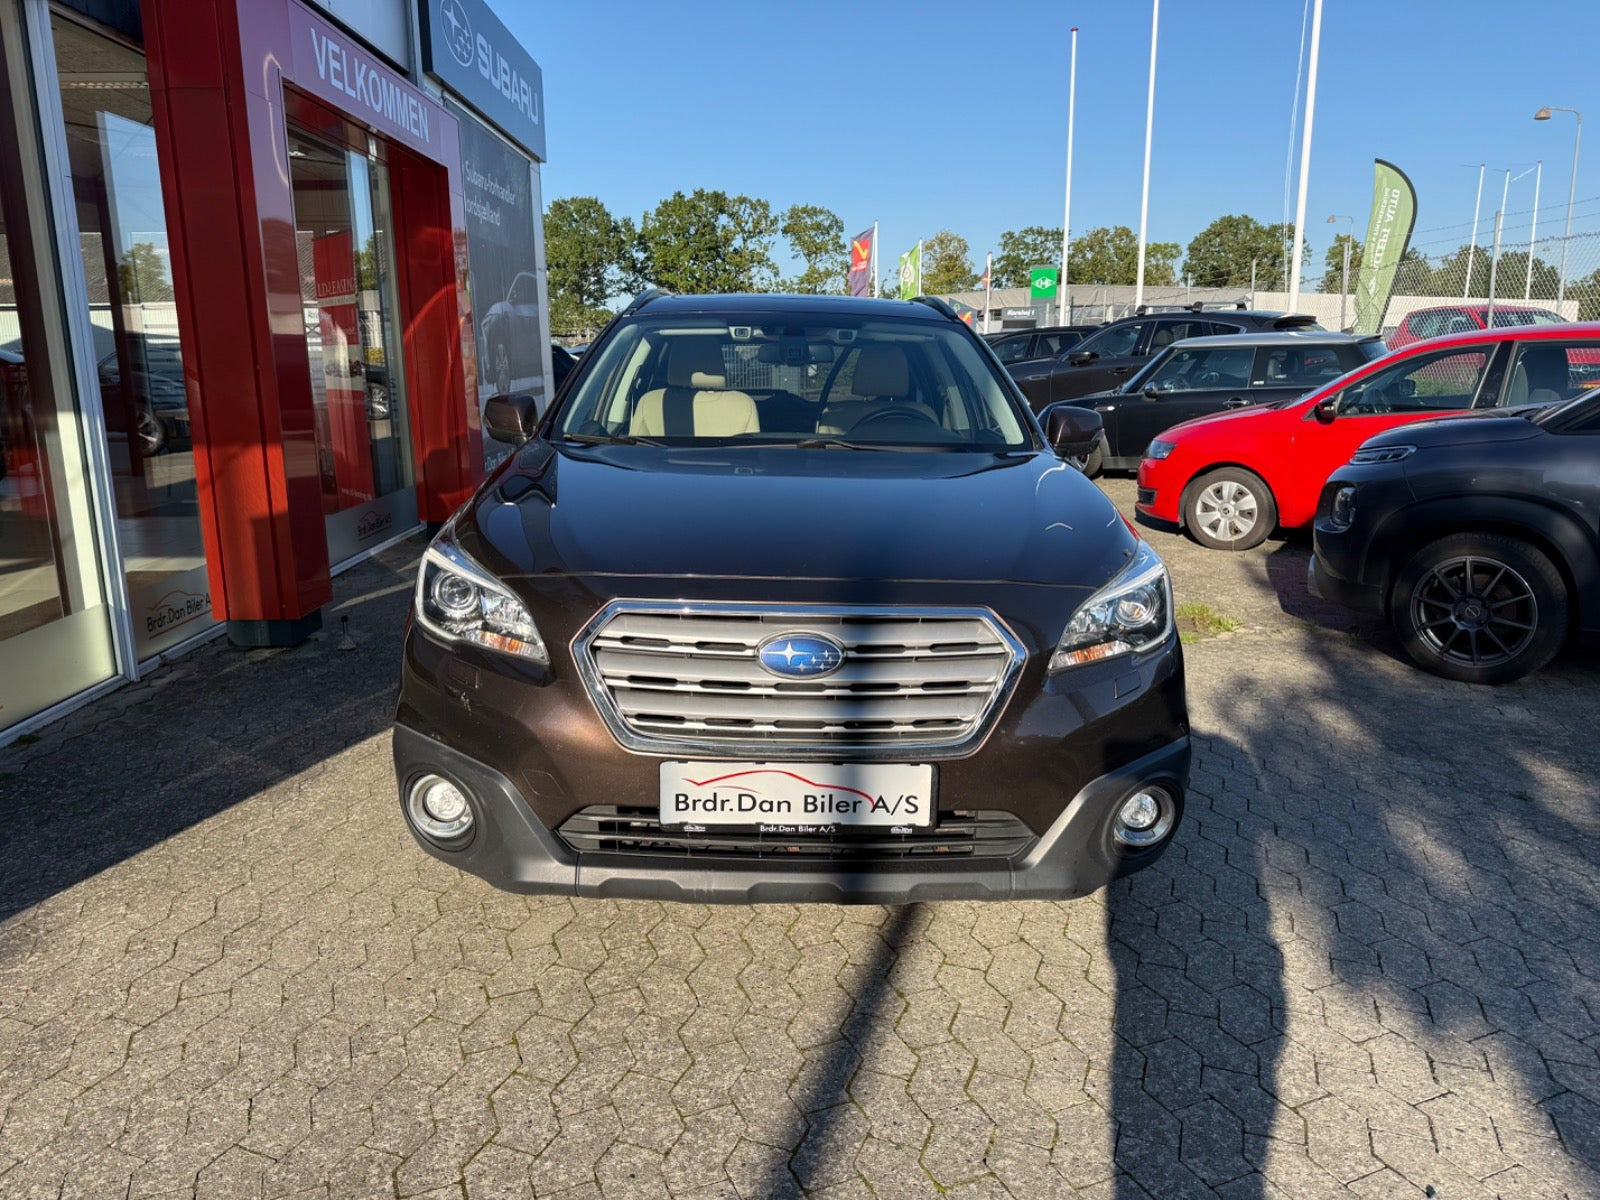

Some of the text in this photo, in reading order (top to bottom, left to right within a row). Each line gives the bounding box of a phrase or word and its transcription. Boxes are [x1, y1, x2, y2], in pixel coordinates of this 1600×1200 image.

[310, 27, 429, 143] VELKOMMEN
[476, 32, 538, 125] SUBARU
[147, 608, 186, 632] Brdr.Dan
[186, 598, 204, 615] Biler
[675, 793, 919, 815] Brdr.Dan Biler A/S
[819, 825, 836, 833] A/S
